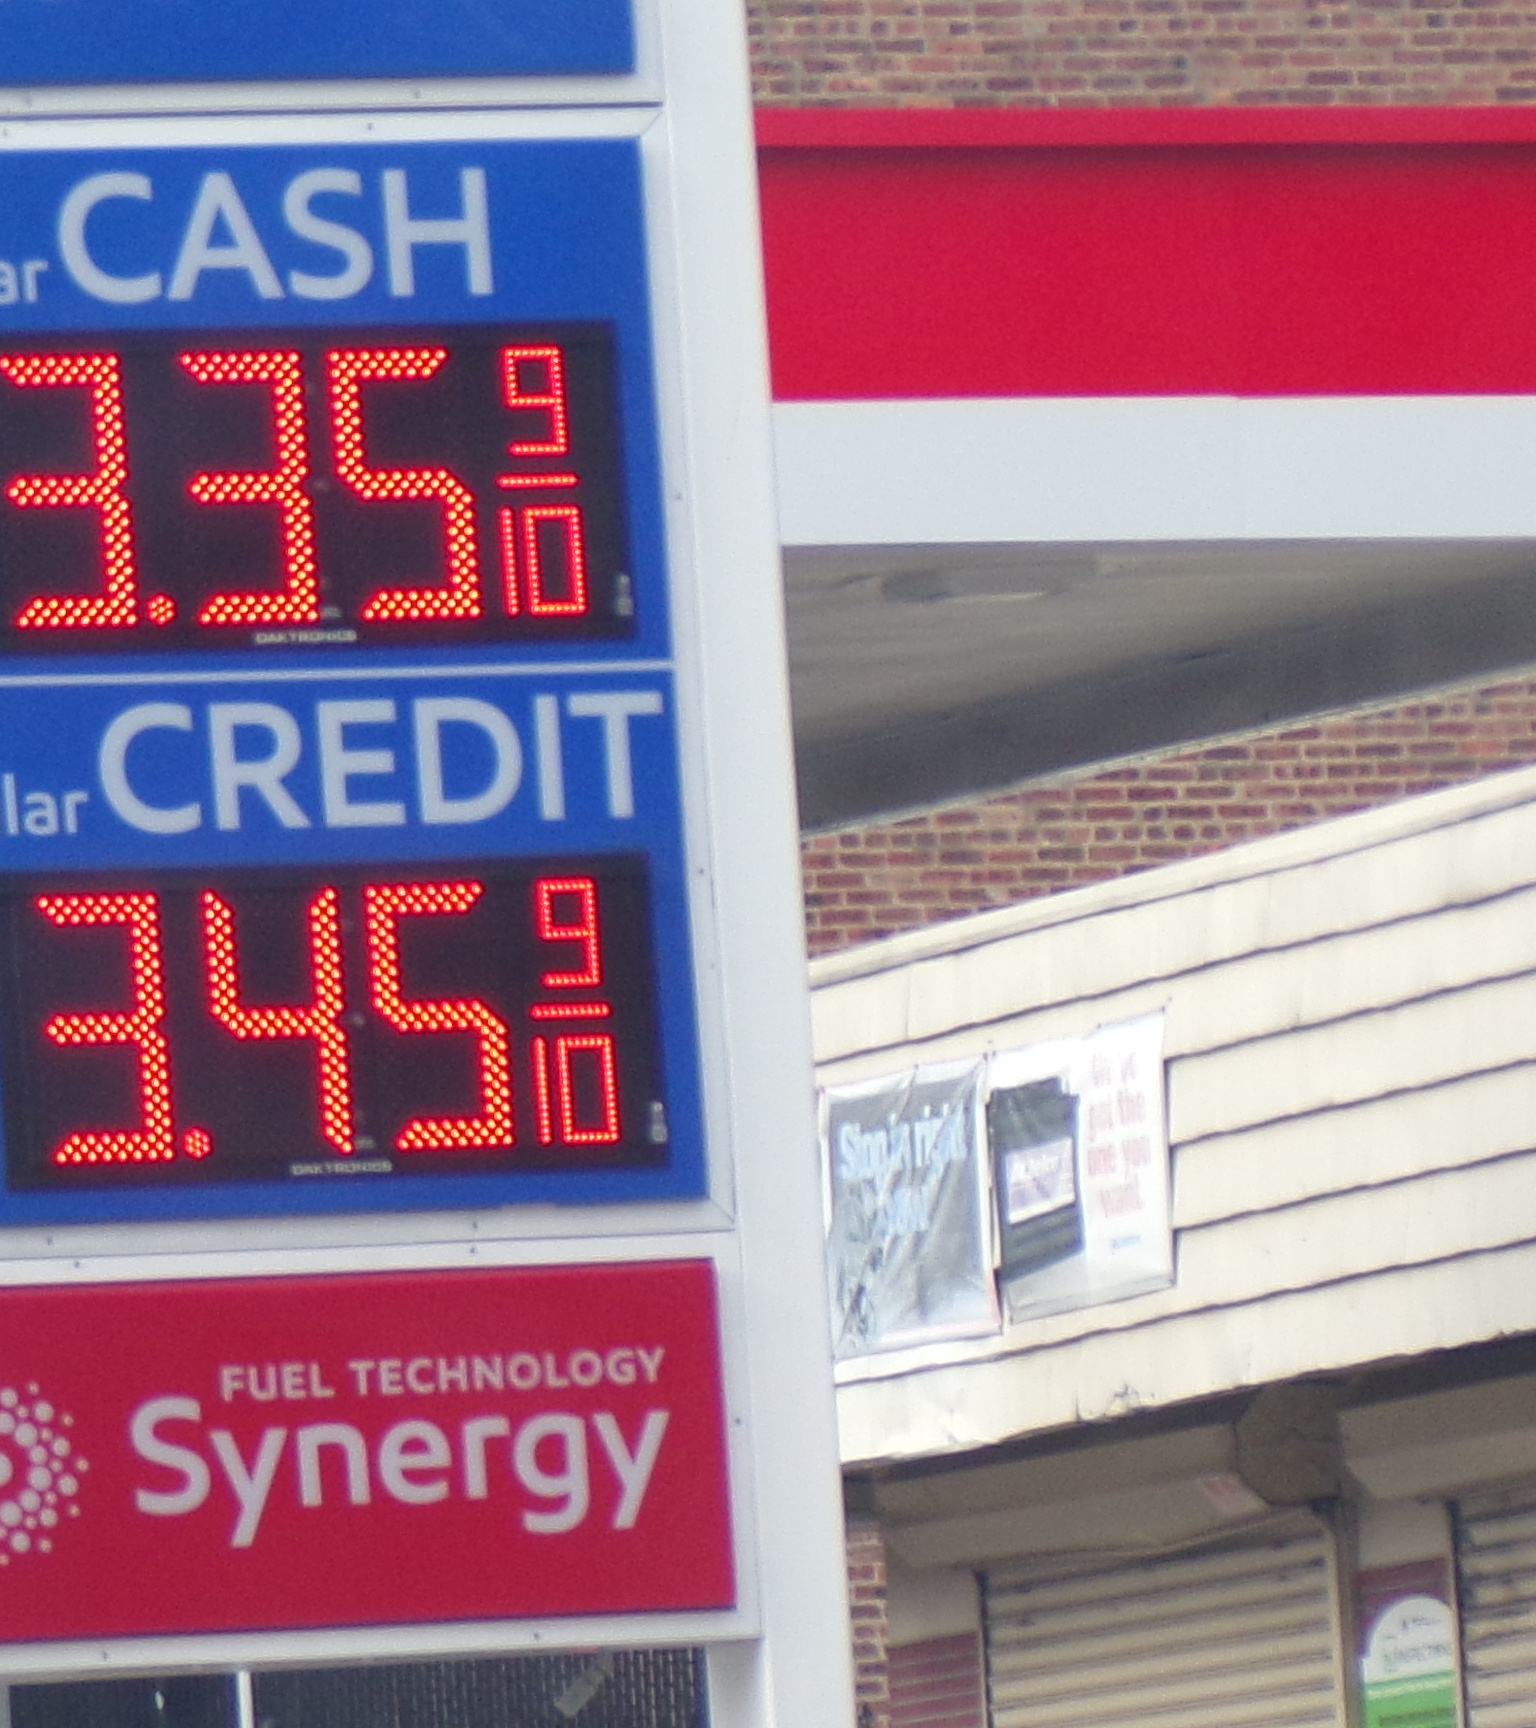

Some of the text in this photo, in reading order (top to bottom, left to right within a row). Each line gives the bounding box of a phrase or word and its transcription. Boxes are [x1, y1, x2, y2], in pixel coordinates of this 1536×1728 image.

[57, 167, 495, 304] CASH
[98, 691, 663, 835] CREDIT
[34, 880, 517, 1165] 3.45
[220, 1347, 665, 1401] FUEL TECHNOLOGY
[130, 1395, 670, 1549] Synergy
